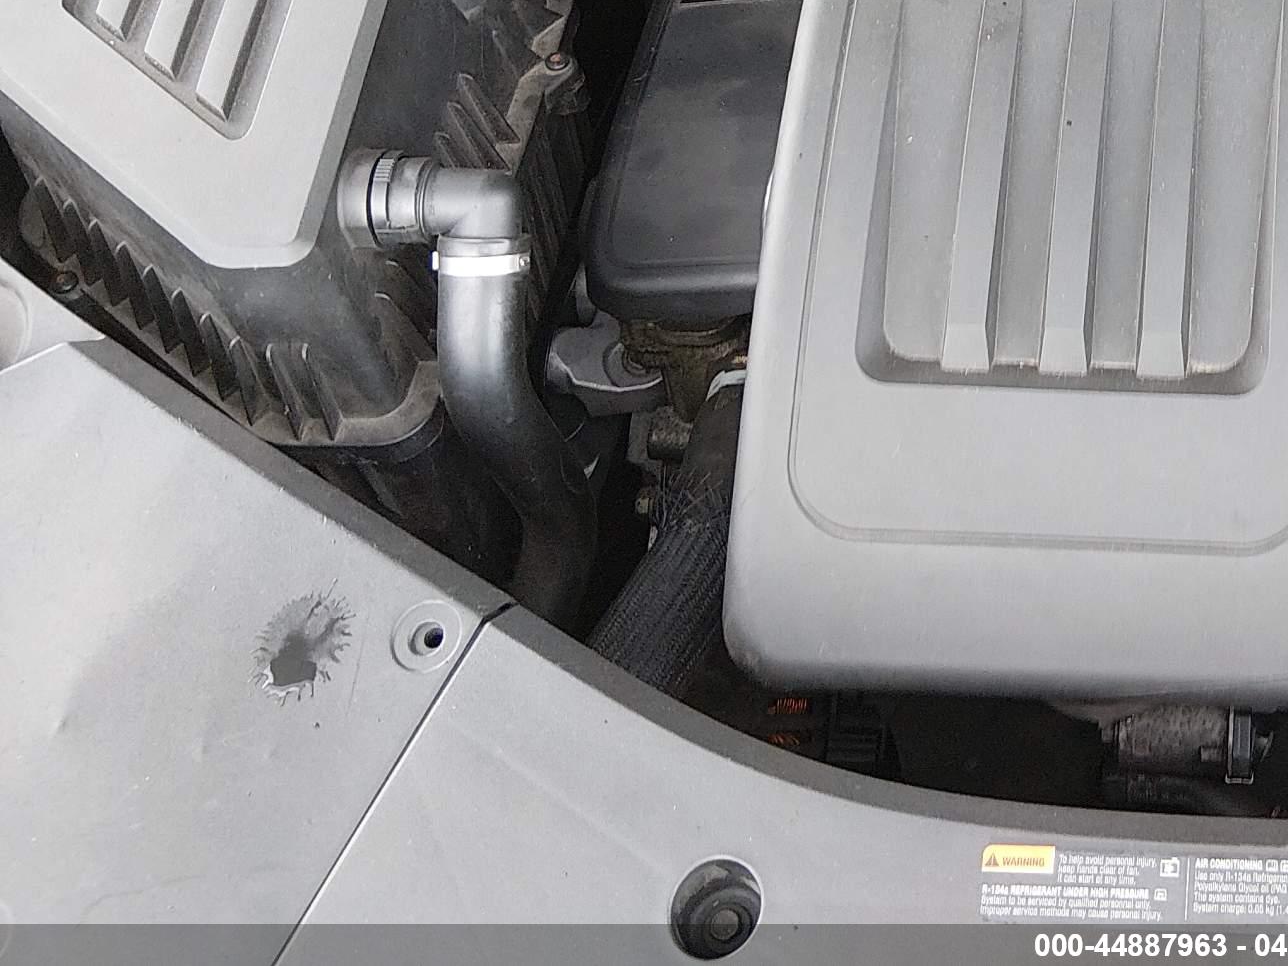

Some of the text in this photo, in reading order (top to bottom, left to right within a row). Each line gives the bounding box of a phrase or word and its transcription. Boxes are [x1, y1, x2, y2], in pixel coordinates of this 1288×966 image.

[1002, 857, 1045, 867] WARNING
[1086, 854, 1104, 865] avoid
[1106, 855, 1135, 867] personal
[1195, 858, 1262, 871] AIR CONDITIONING
[1010, 885, 1061, 896] REFRIGERANT
[1063, 886, 1089, 897] UNDER
[1090, 888, 1108, 898] HIGH
[1110, 888, 1149, 900] PRESSURE
